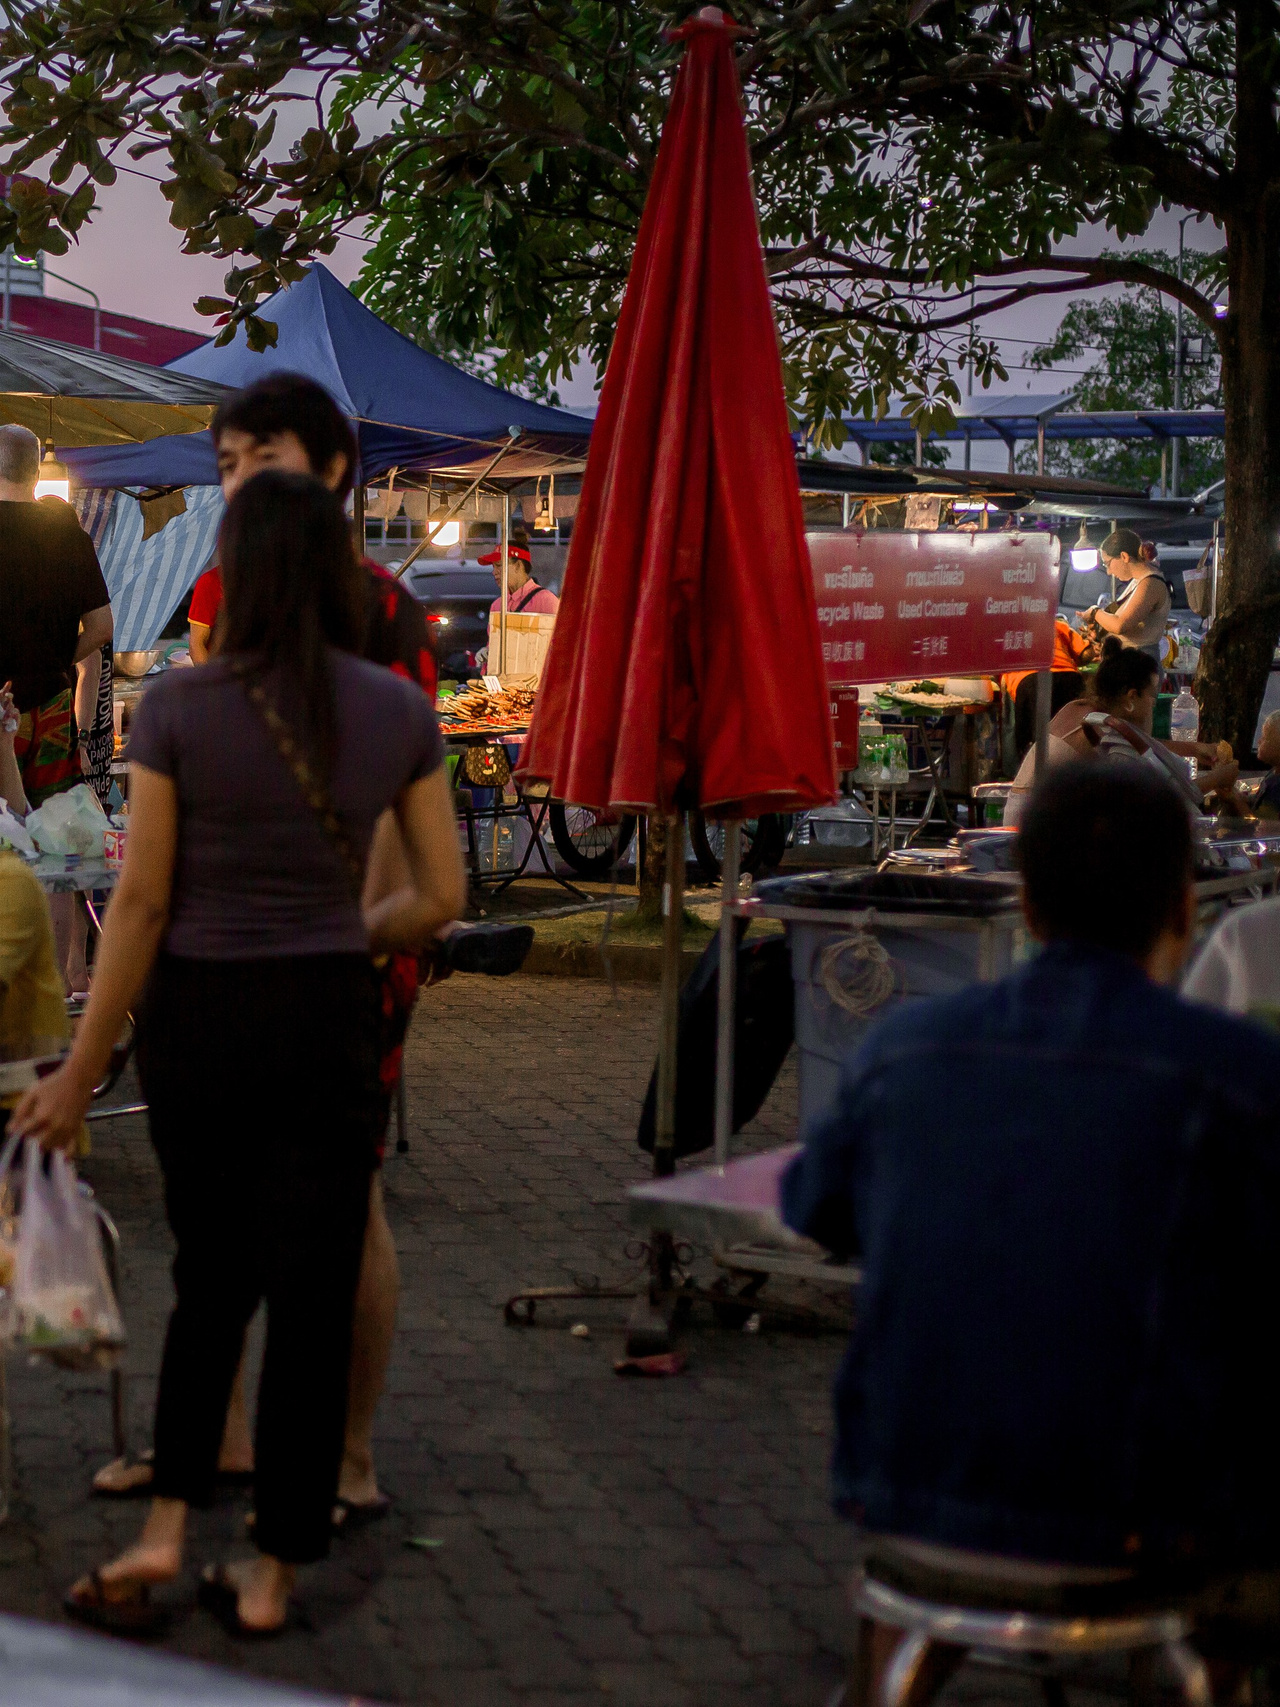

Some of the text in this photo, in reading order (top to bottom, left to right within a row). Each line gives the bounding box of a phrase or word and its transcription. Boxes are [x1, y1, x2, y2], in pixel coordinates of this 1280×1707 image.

[817, 602, 884, 626] ecycle Waste
[898, 599, 969, 619] Used Container
[985, 595, 1048, 615] General Waste
[90, 743, 112, 763] PARIS
